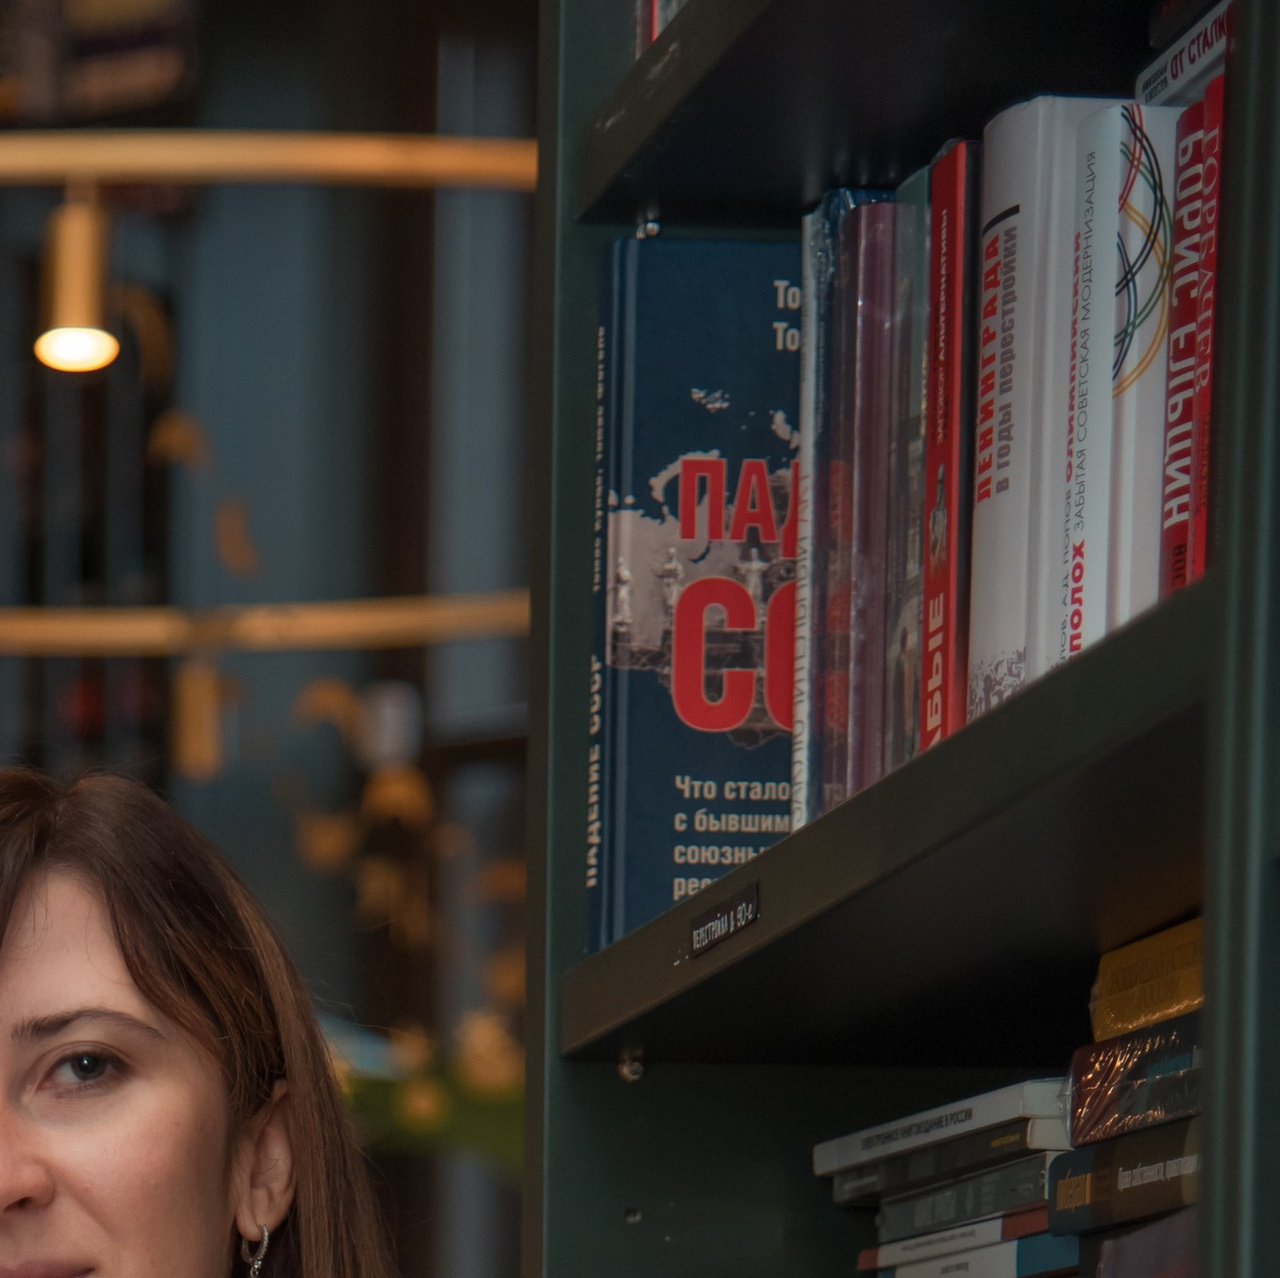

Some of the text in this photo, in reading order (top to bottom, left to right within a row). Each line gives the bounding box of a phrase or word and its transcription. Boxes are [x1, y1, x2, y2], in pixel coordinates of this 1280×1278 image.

[1188, 10, 1227, 65] СТАЛИ
[1171, 130, 1204, 306] БОРИС
[773, 279, 802, 309] То
[998, 225, 1018, 395] перестройки
[772, 321, 801, 351] То
[976, 231, 1002, 503] ЛЕНИНГРАДА
[1070, 150, 1096, 651] ПОЛОХ ЗАБЫТАЯ СОВЕТСКАЯ МОДЕРНИЗАЦИЯ
[1163, 322, 1196, 530] ЕЛЬЦИН
[996, 401, 1015, 469] годы
[926, 592, 944, 749] БЫЕ
[673, 808, 791, 832] с бывшим
[674, 775, 791, 800] Что стало
[673, 845, 768, 866] союзны
